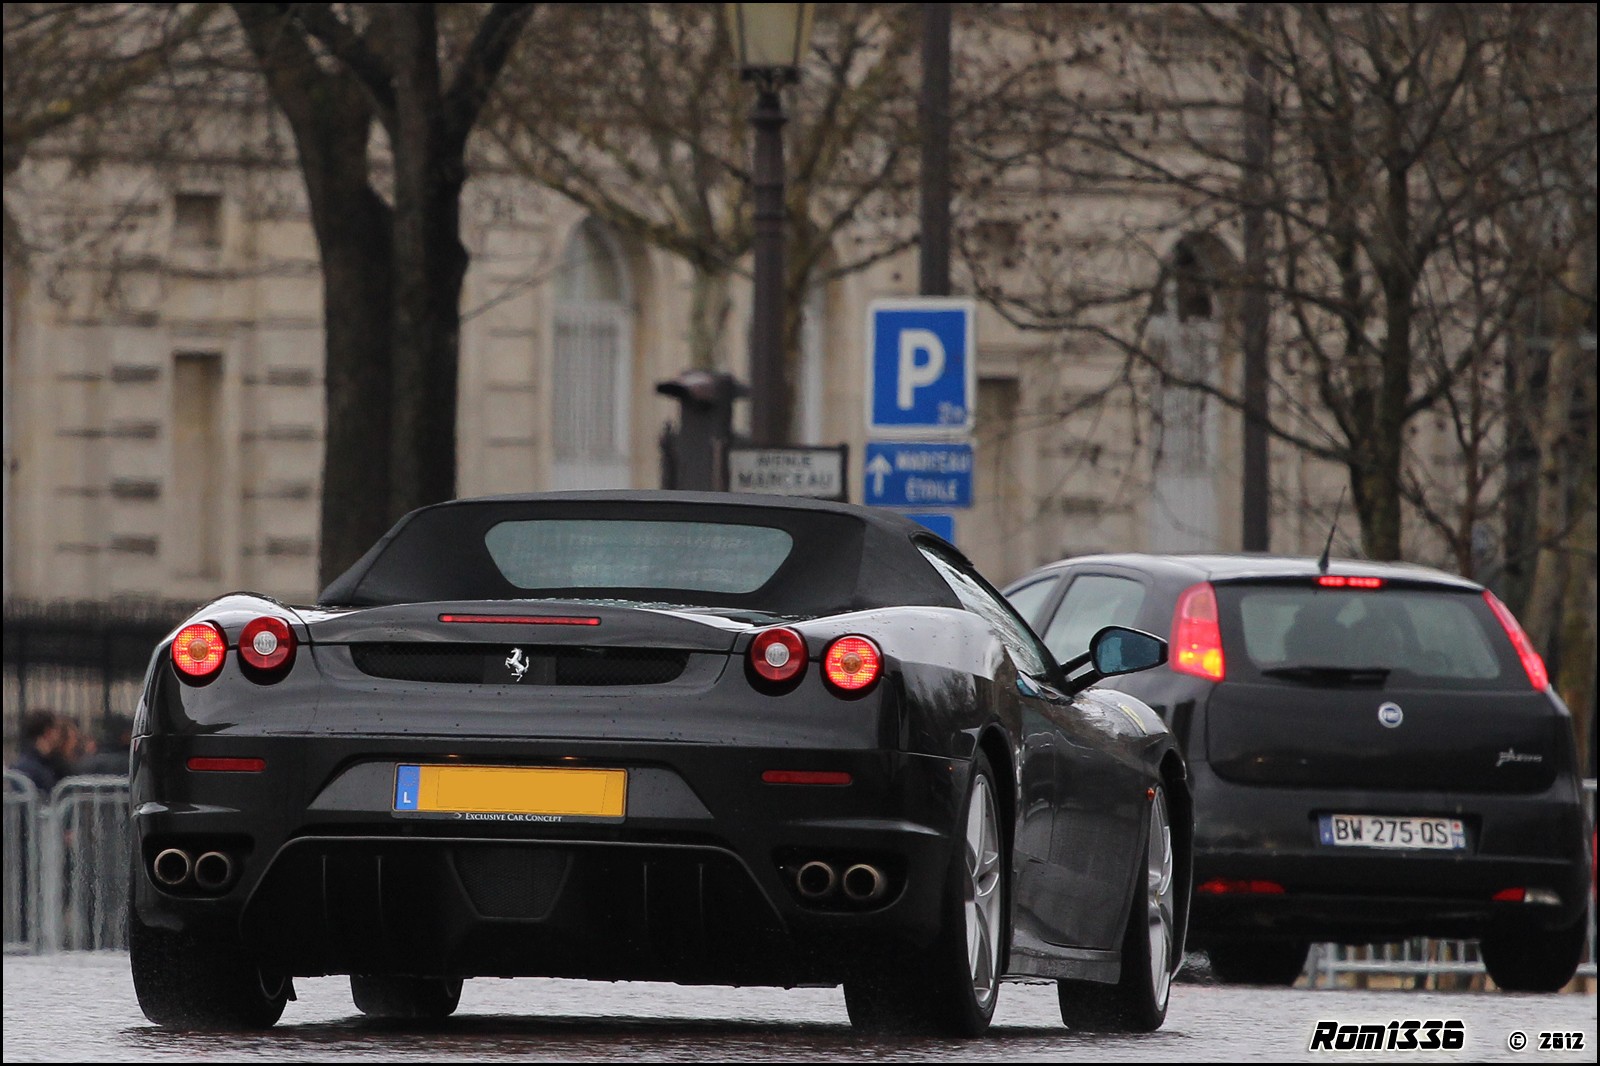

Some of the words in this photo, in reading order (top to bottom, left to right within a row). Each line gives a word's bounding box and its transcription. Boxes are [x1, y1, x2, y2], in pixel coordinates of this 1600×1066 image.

[897, 328, 946, 411] P
[896, 451, 971, 474] MARCEAU
[738, 470, 834, 489] MARCEAU
[403, 791, 412, 804] L
[465, 812, 506, 821] EXCLUSIVE
[507, 813, 524, 822] CAR
[525, 814, 563, 823] CONCEPT
